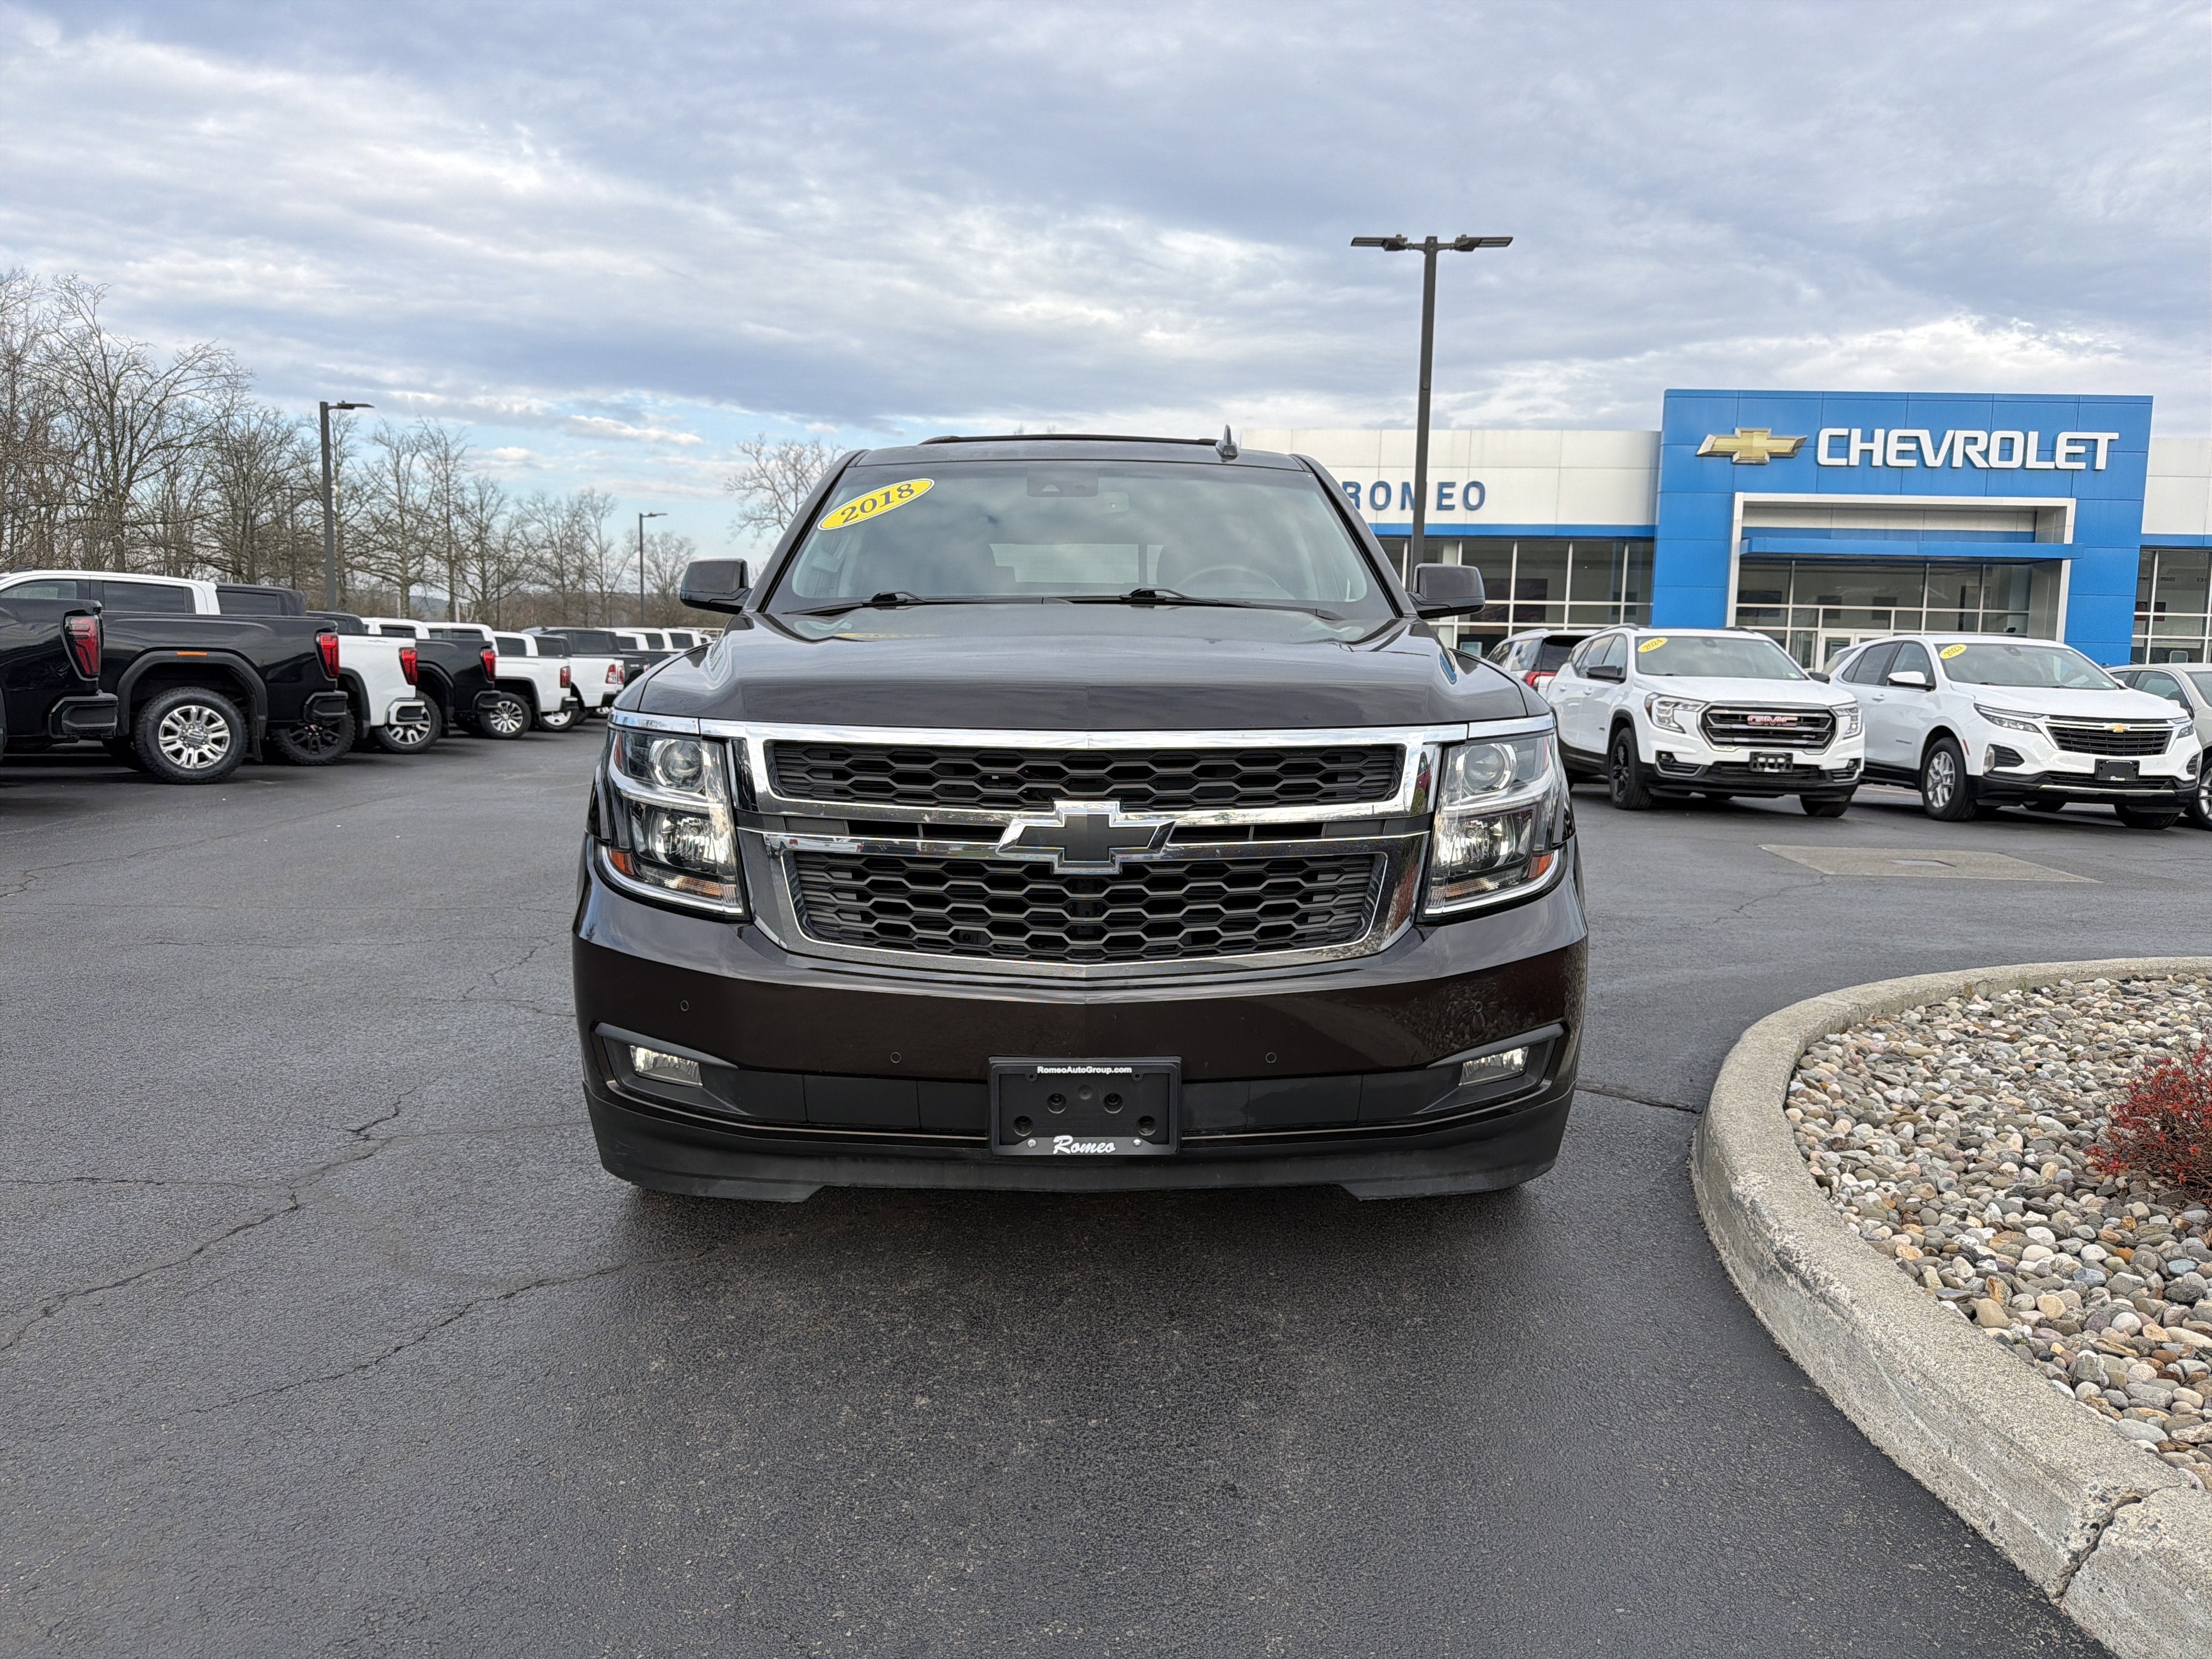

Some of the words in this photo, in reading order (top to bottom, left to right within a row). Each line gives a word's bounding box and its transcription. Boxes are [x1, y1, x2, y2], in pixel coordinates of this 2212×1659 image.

[1816, 428, 2119, 470] CHEVROLET
[840, 483, 915, 524] 2018
[1747, 715, 1798, 726] GMC
[1037, 1066, 1132, 1074] RomeoAutoGroup.com
[1053, 1135, 1116, 1155] Romeo
